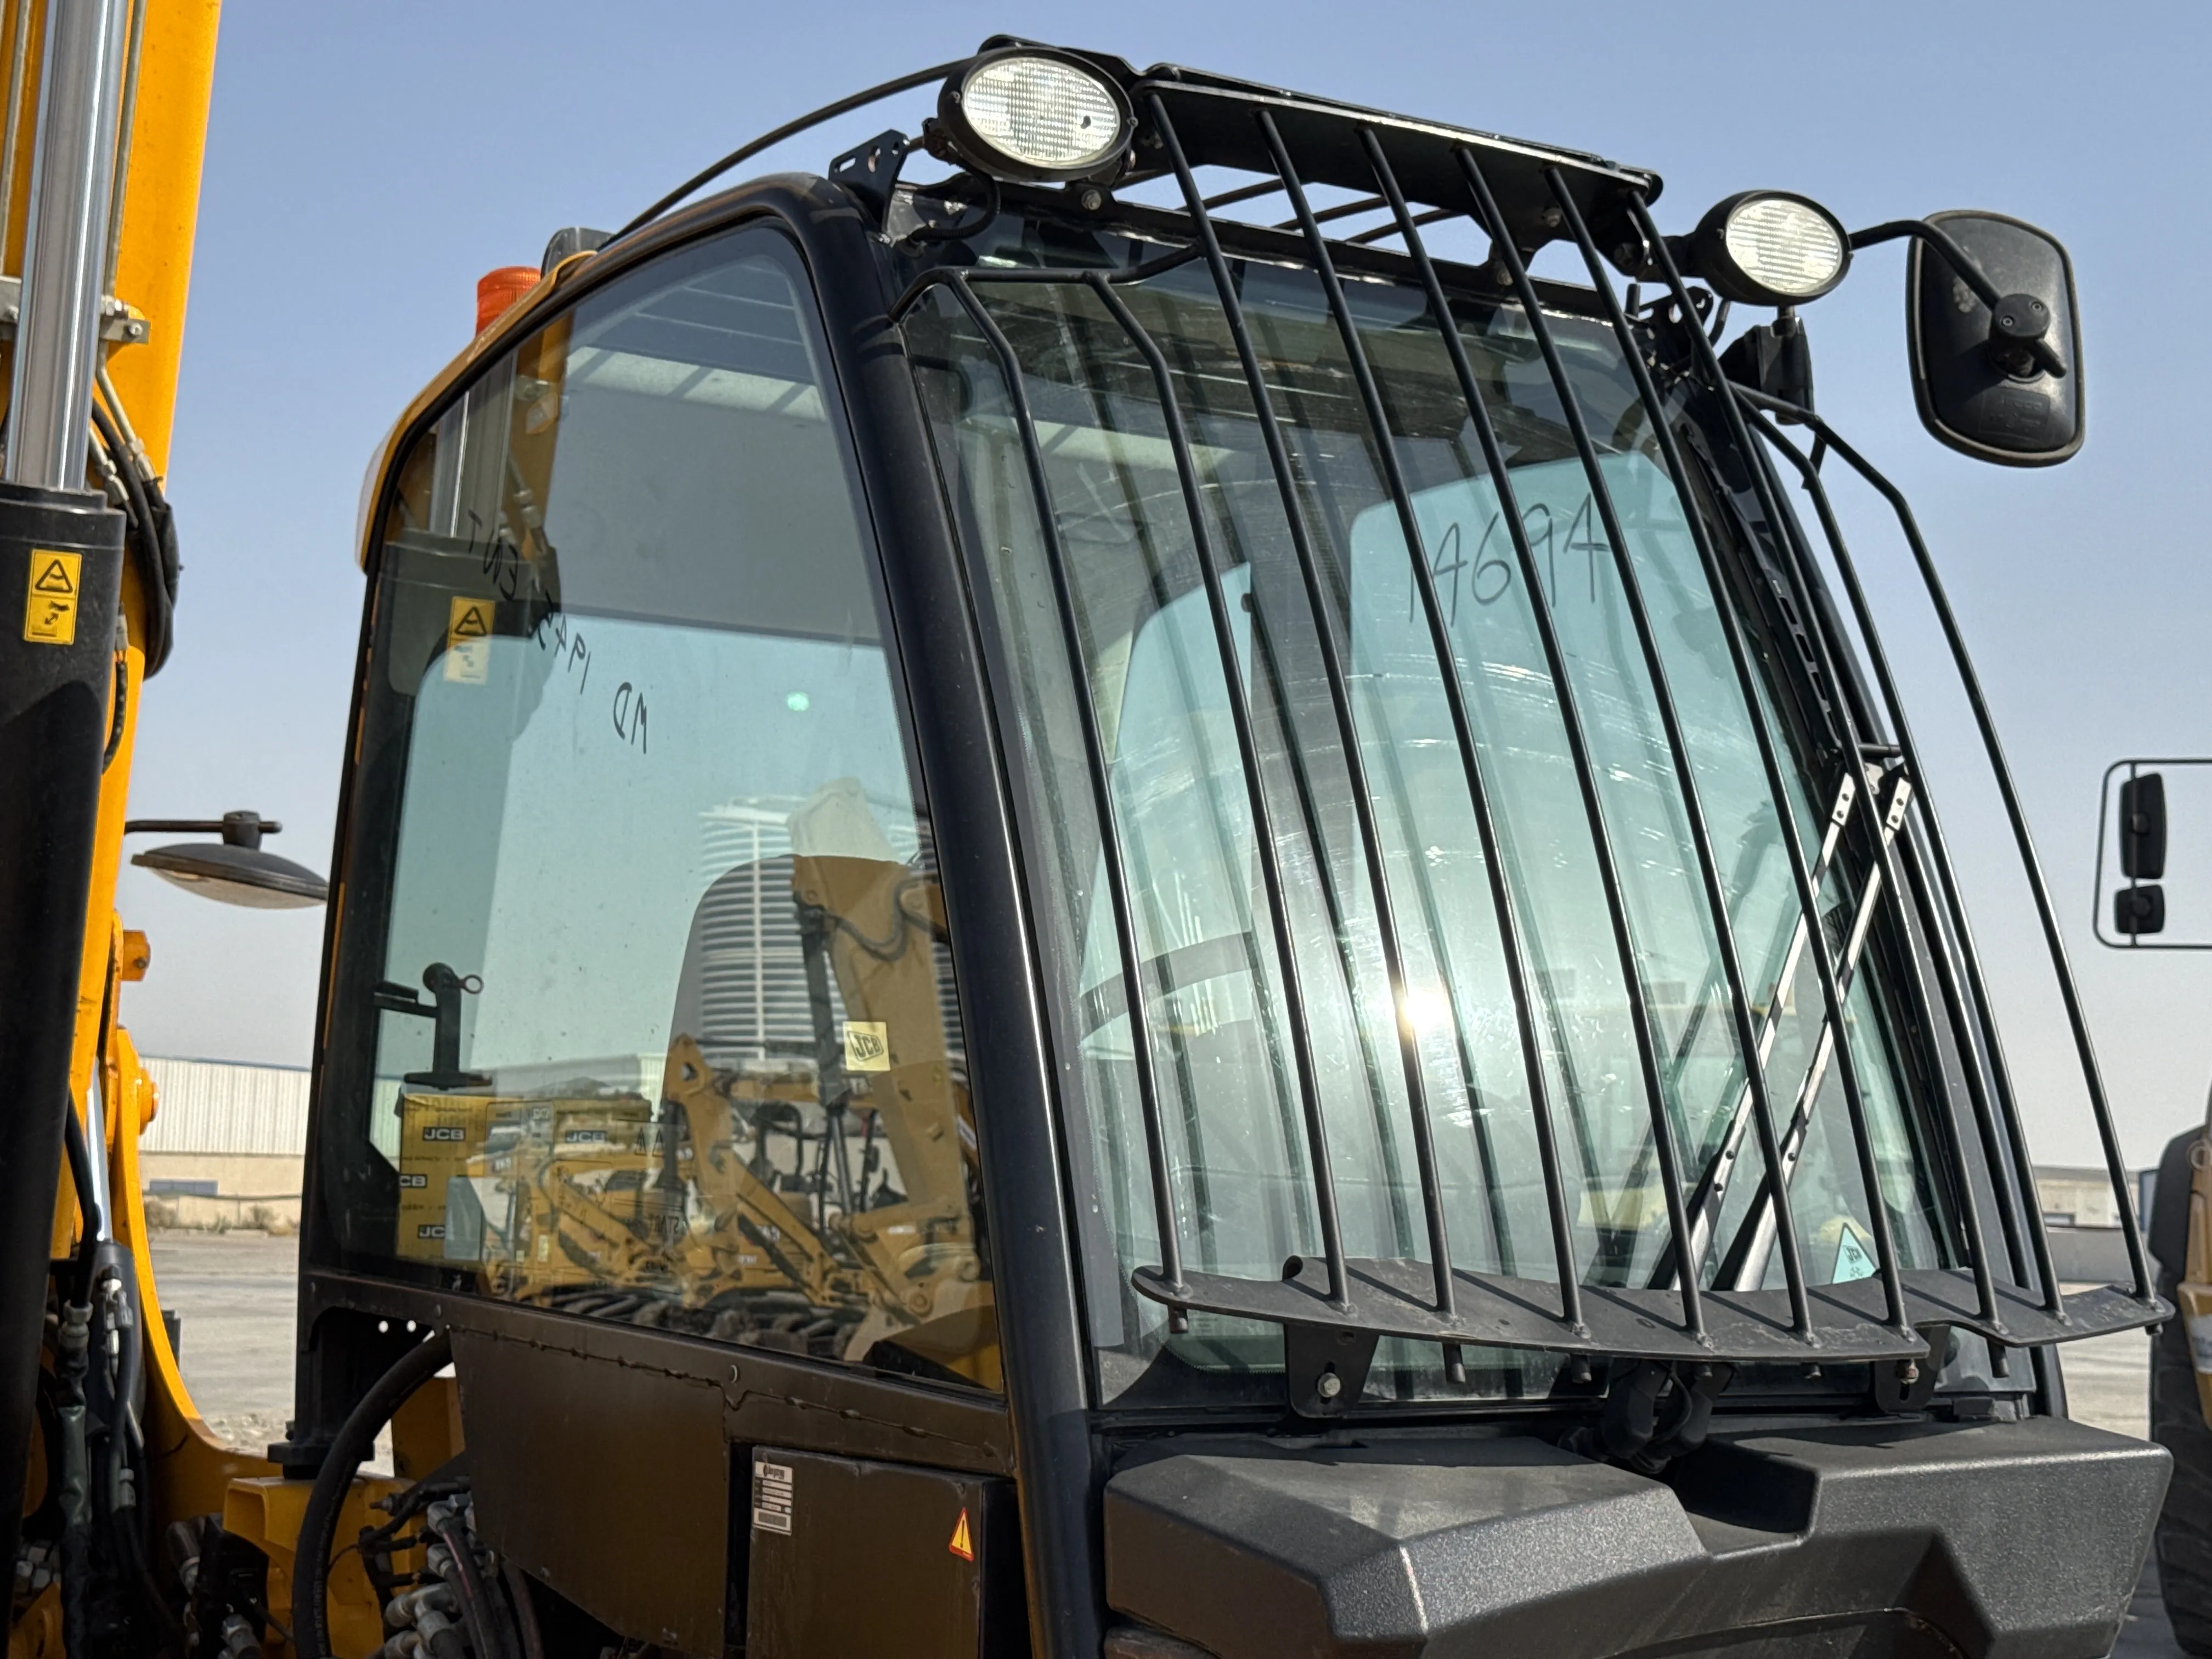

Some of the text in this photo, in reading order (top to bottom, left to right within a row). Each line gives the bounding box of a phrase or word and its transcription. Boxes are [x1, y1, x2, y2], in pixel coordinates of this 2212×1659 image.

[854, 1034, 881, 1058] JCB
[424, 1128, 465, 1141] JCB
[566, 1131, 606, 1143] JCB
[399, 1175, 426, 1187] CB
[419, 1226, 446, 1238] JC
